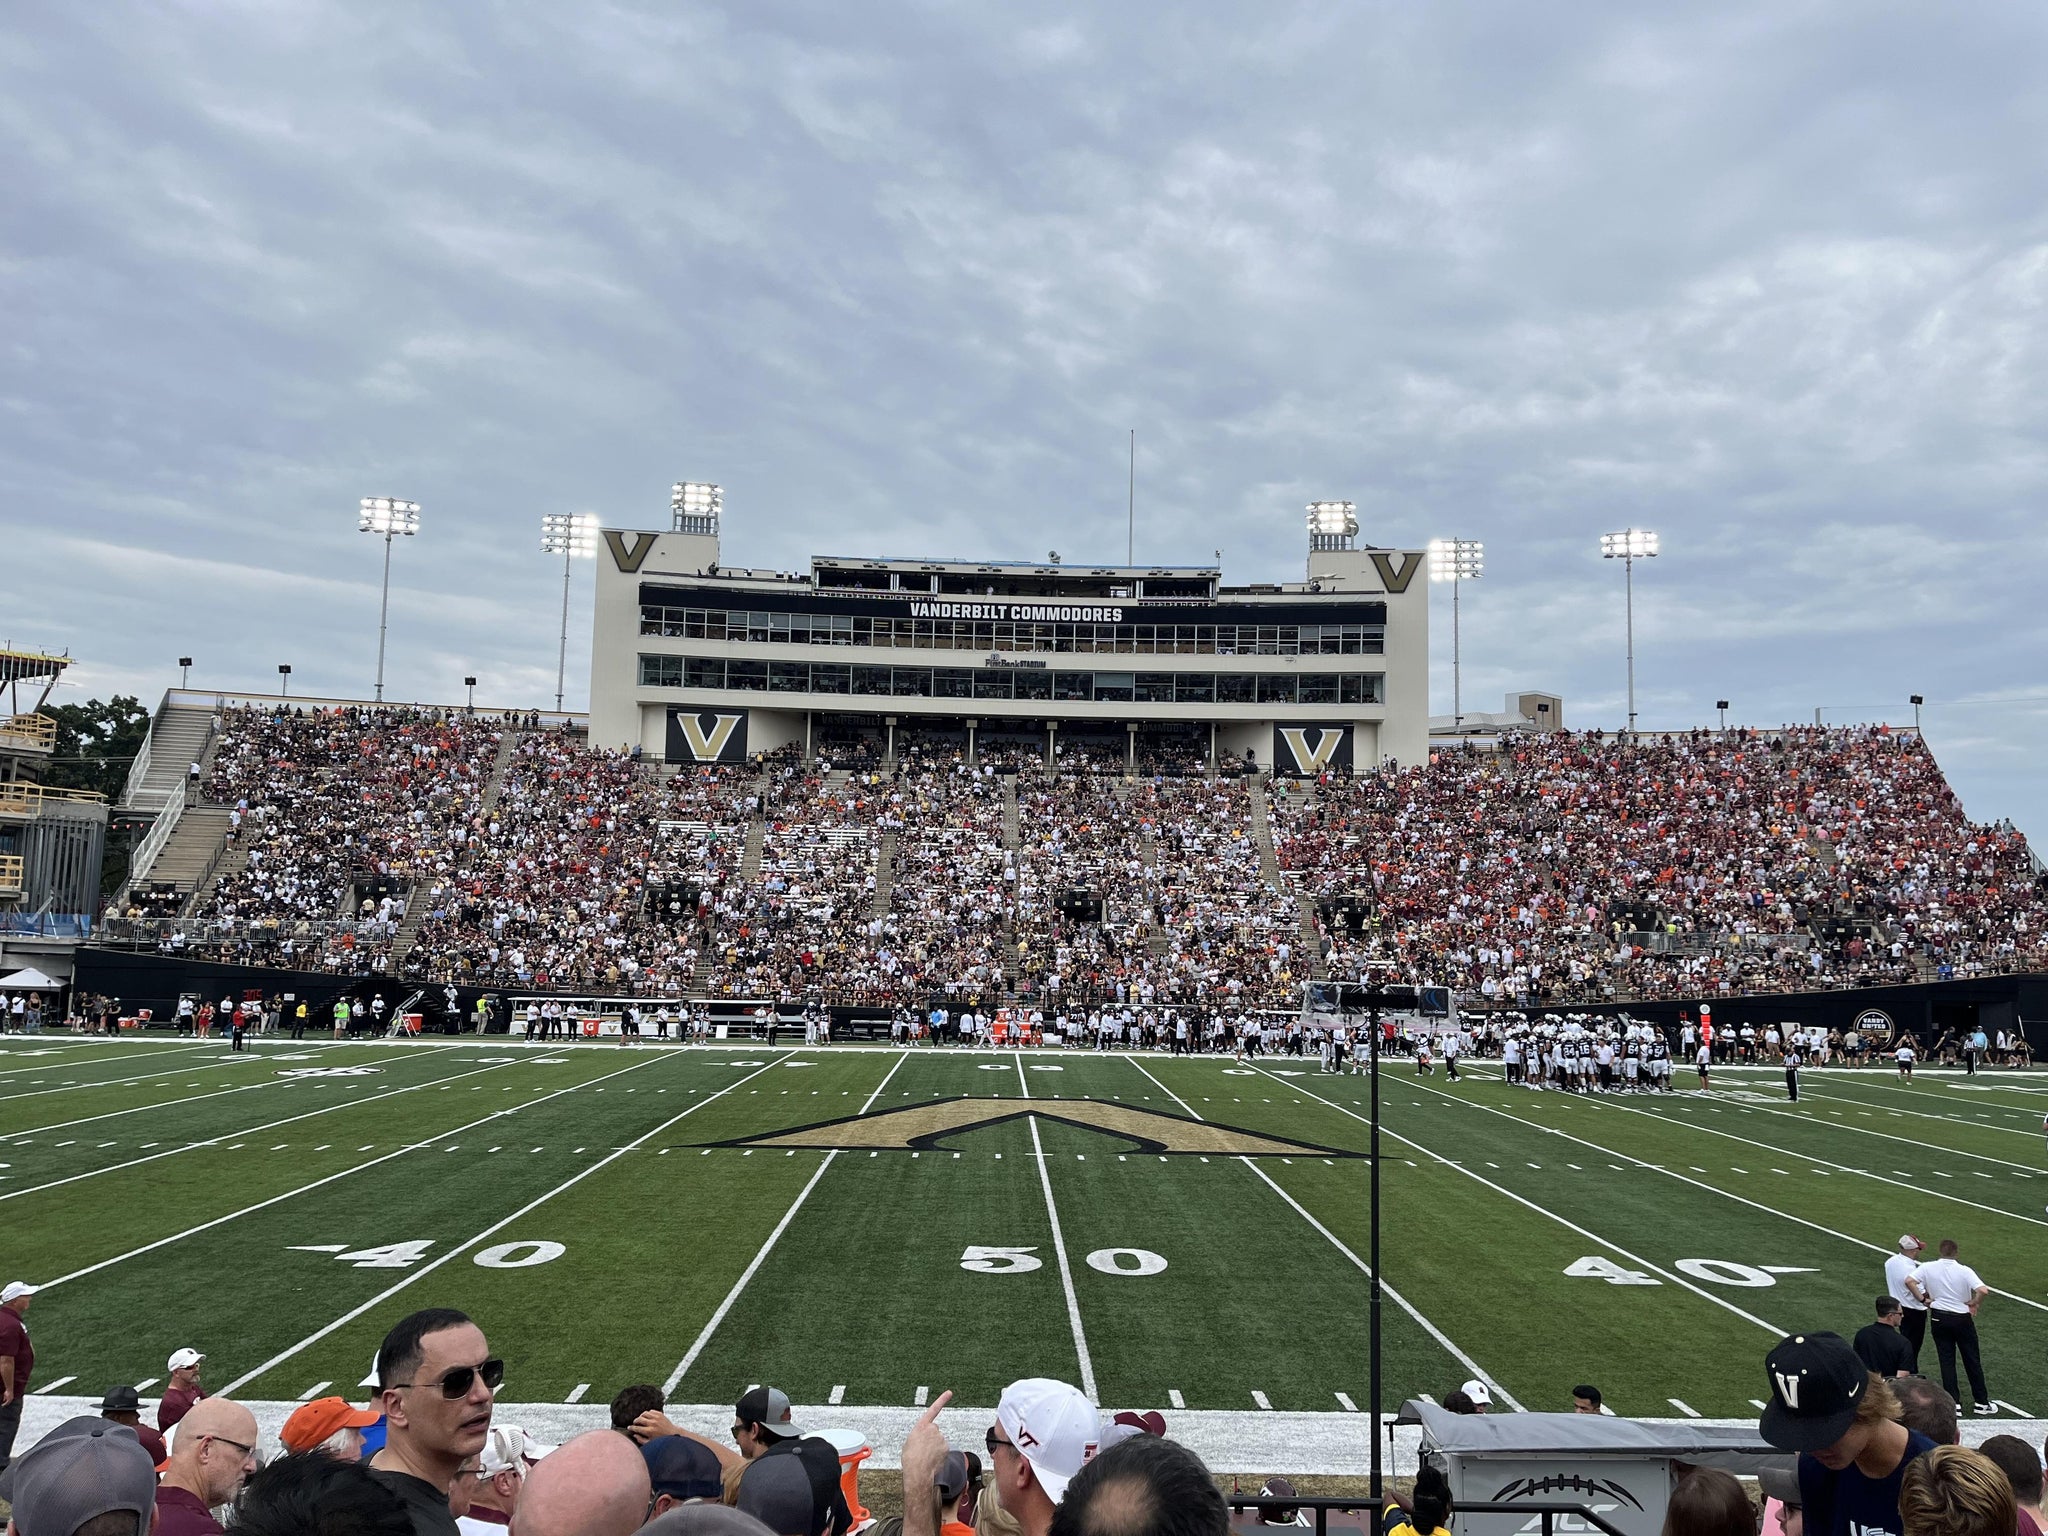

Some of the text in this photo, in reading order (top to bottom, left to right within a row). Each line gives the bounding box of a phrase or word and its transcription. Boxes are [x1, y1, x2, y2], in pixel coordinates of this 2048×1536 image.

[602, 530, 660, 573] V
[1368, 553, 1425, 593] V
[910, 602, 1123, 622] VANDERBILT COMMODORES
[677, 713, 743, 761] V
[1279, 728, 1344, 775] V
[585, 1022, 595, 1031] G
[1775, 1371, 1799, 1409] V
[1017, 1425, 1040, 1448] VT
